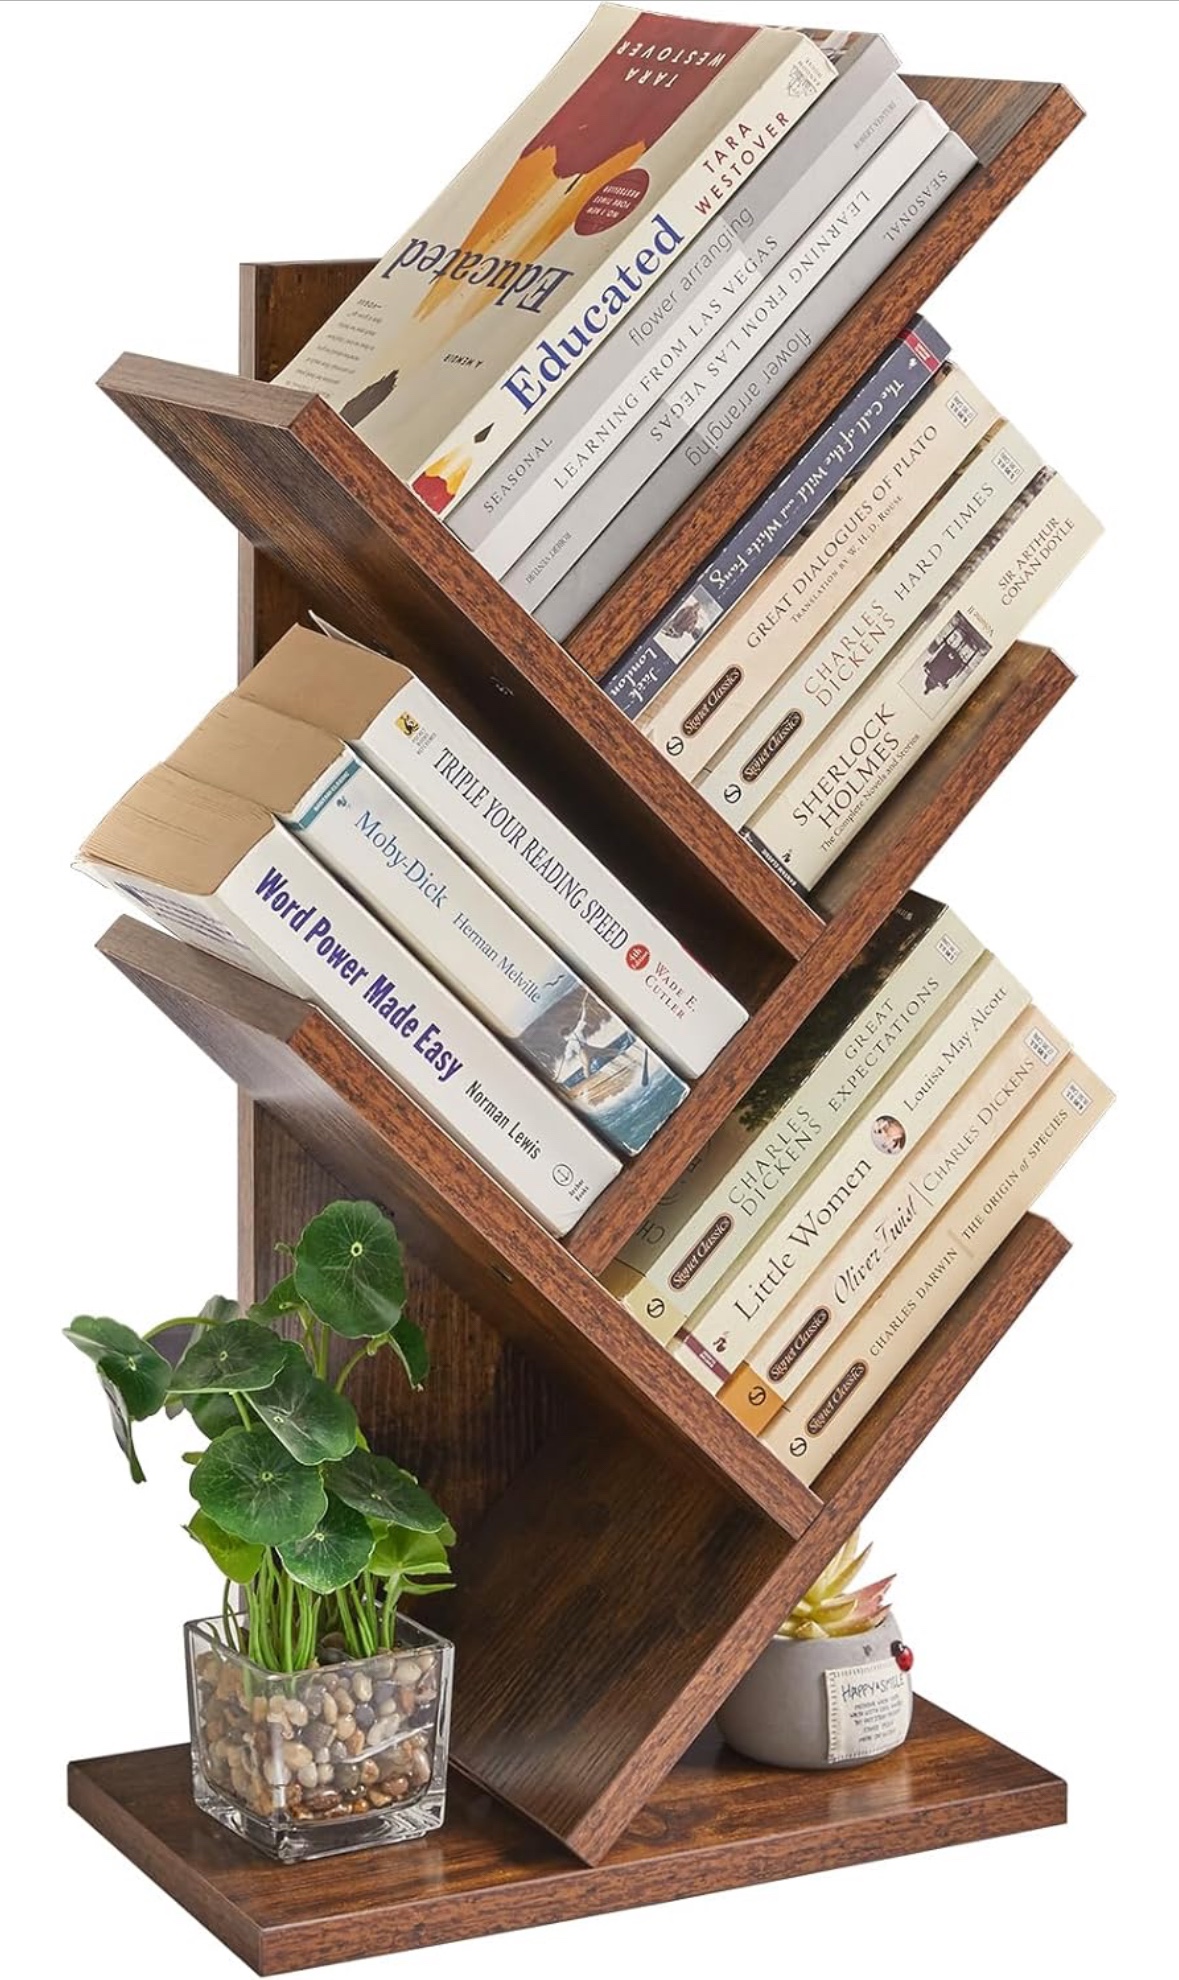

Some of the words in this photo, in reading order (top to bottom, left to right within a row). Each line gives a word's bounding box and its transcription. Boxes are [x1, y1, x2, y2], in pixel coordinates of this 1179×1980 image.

[617, 40, 726, 68] WESTOVER
[625, 67, 679, 88] TARA
[694, 112, 790, 217] WESTOVER
[702, 122, 753, 175] TARA
[788, 191, 871, 284] LEARNING
[883, 169, 949, 243] SEASONAL
[381, 237, 574, 314] Educated
[629, 290, 678, 347] flower
[680, 206, 756, 294] arranging
[501, 214, 685, 415] Educated
[740, 287, 789, 344] FROM
[552, 393, 640, 490] LEARNING
[640, 338, 688, 392] FROM
[688, 298, 723, 338] LAS
[723, 235, 780, 296] VEGAS
[706, 339, 741, 379] LAS
[762, 328, 813, 385] flower
[883, 378, 905, 400] The
[650, 382, 707, 443] VEGAS
[684, 381, 762, 468] arranging
[843, 426, 858, 453] of
[856, 400, 885, 433] Call
[484, 437, 554, 514] SEASONAL
[796, 469, 828, 502] Wild
[824, 445, 847, 468] the
[709, 554, 750, 590] Fang
[746, 594, 793, 650] GREAT
[791, 501, 875, 596] DIALOGUES
[871, 476, 894, 503] OF
[892, 425, 938, 478] PLATO
[749, 517, 787, 556] White
[847, 541, 860, 561] W.
[857, 530, 870, 546] H.
[868, 519, 882, 534] D.
[893, 541, 943, 602] HARD
[943, 481, 996, 542] TIMES
[996, 568, 1016, 592] SIR
[1013, 516, 1061, 570] ARTHUR
[1000, 558, 1043, 607] CONAN
[1040, 517, 1076, 562] DOYLE
[610, 648, 655, 698] London
[627, 665, 659, 703] Jack
[804, 600, 885, 696] CHARLES
[814, 613, 897, 707] DICKENS
[683, 707, 708, 735] Signet
[706, 670, 742, 709] Classics
[743, 753, 769, 783] Signet
[767, 711, 802, 756] Classics
[792, 702, 896, 828] SHERLOCK
[817, 731, 901, 830] HOLMES
[819, 836, 835, 854] The
[832, 799, 866, 838] Complete
[863, 771, 888, 801] Novels
[885, 757, 899, 774] and
[897, 732, 921, 761] Stories
[355, 810, 449, 910] Moby-Dick
[433, 747, 490, 808] TRIPLE
[482, 797, 528, 850] YOUR
[520, 838, 589, 909] READING
[580, 899, 630, 950] SPEED
[254, 866, 318, 932] Word
[303, 916, 369, 987] Power
[363, 974, 420, 1038] Made
[412, 1023, 464, 1083] Easy
[452, 912, 499, 962] Herman
[497, 954, 543, 1003] Melville
[684, 994, 698, 1013] E.
[844, 997, 896, 1060] GREAT
[828, 976, 941, 1112] EXPECTATIONS
[903, 1062, 946, 1112] Louisa
[946, 1029, 975, 1065] May
[969, 986, 1009, 1032] Alcott
[465, 1080, 516, 1134] Norman
[506, 1121, 542, 1160] Lewis
[728, 1109, 811, 1206] CHARLES
[922, 1124, 981, 1194] CHARLES
[978, 1058, 1036, 1127] DICKENS
[740, 1121, 823, 1217] DICKENS
[960, 1209, 985, 1240] THE
[982, 1170, 1020, 1215] ORIGIN
[1019, 1158, 1032, 1174] of
[1026, 1108, 1070, 1160] SPECIES
[672, 1255, 698, 1290] Signet
[695, 1215, 731, 1264] Classics
[733, 1251, 797, 1322] Little
[788, 1157, 874, 1250] Women
[832, 1249, 882, 1305] Oliver
[873, 1198, 919, 1248] Twist
[869, 1299, 918, 1357] CHARLES
[915, 1246, 960, 1301] DARWIN
[769, 1348, 795, 1382] Signet
[791, 1308, 830, 1356] Classics
[807, 1398, 835, 1434] Signet
[831, 1362, 867, 1408] Classics
[841, 1681, 875, 1703] HAPPY
